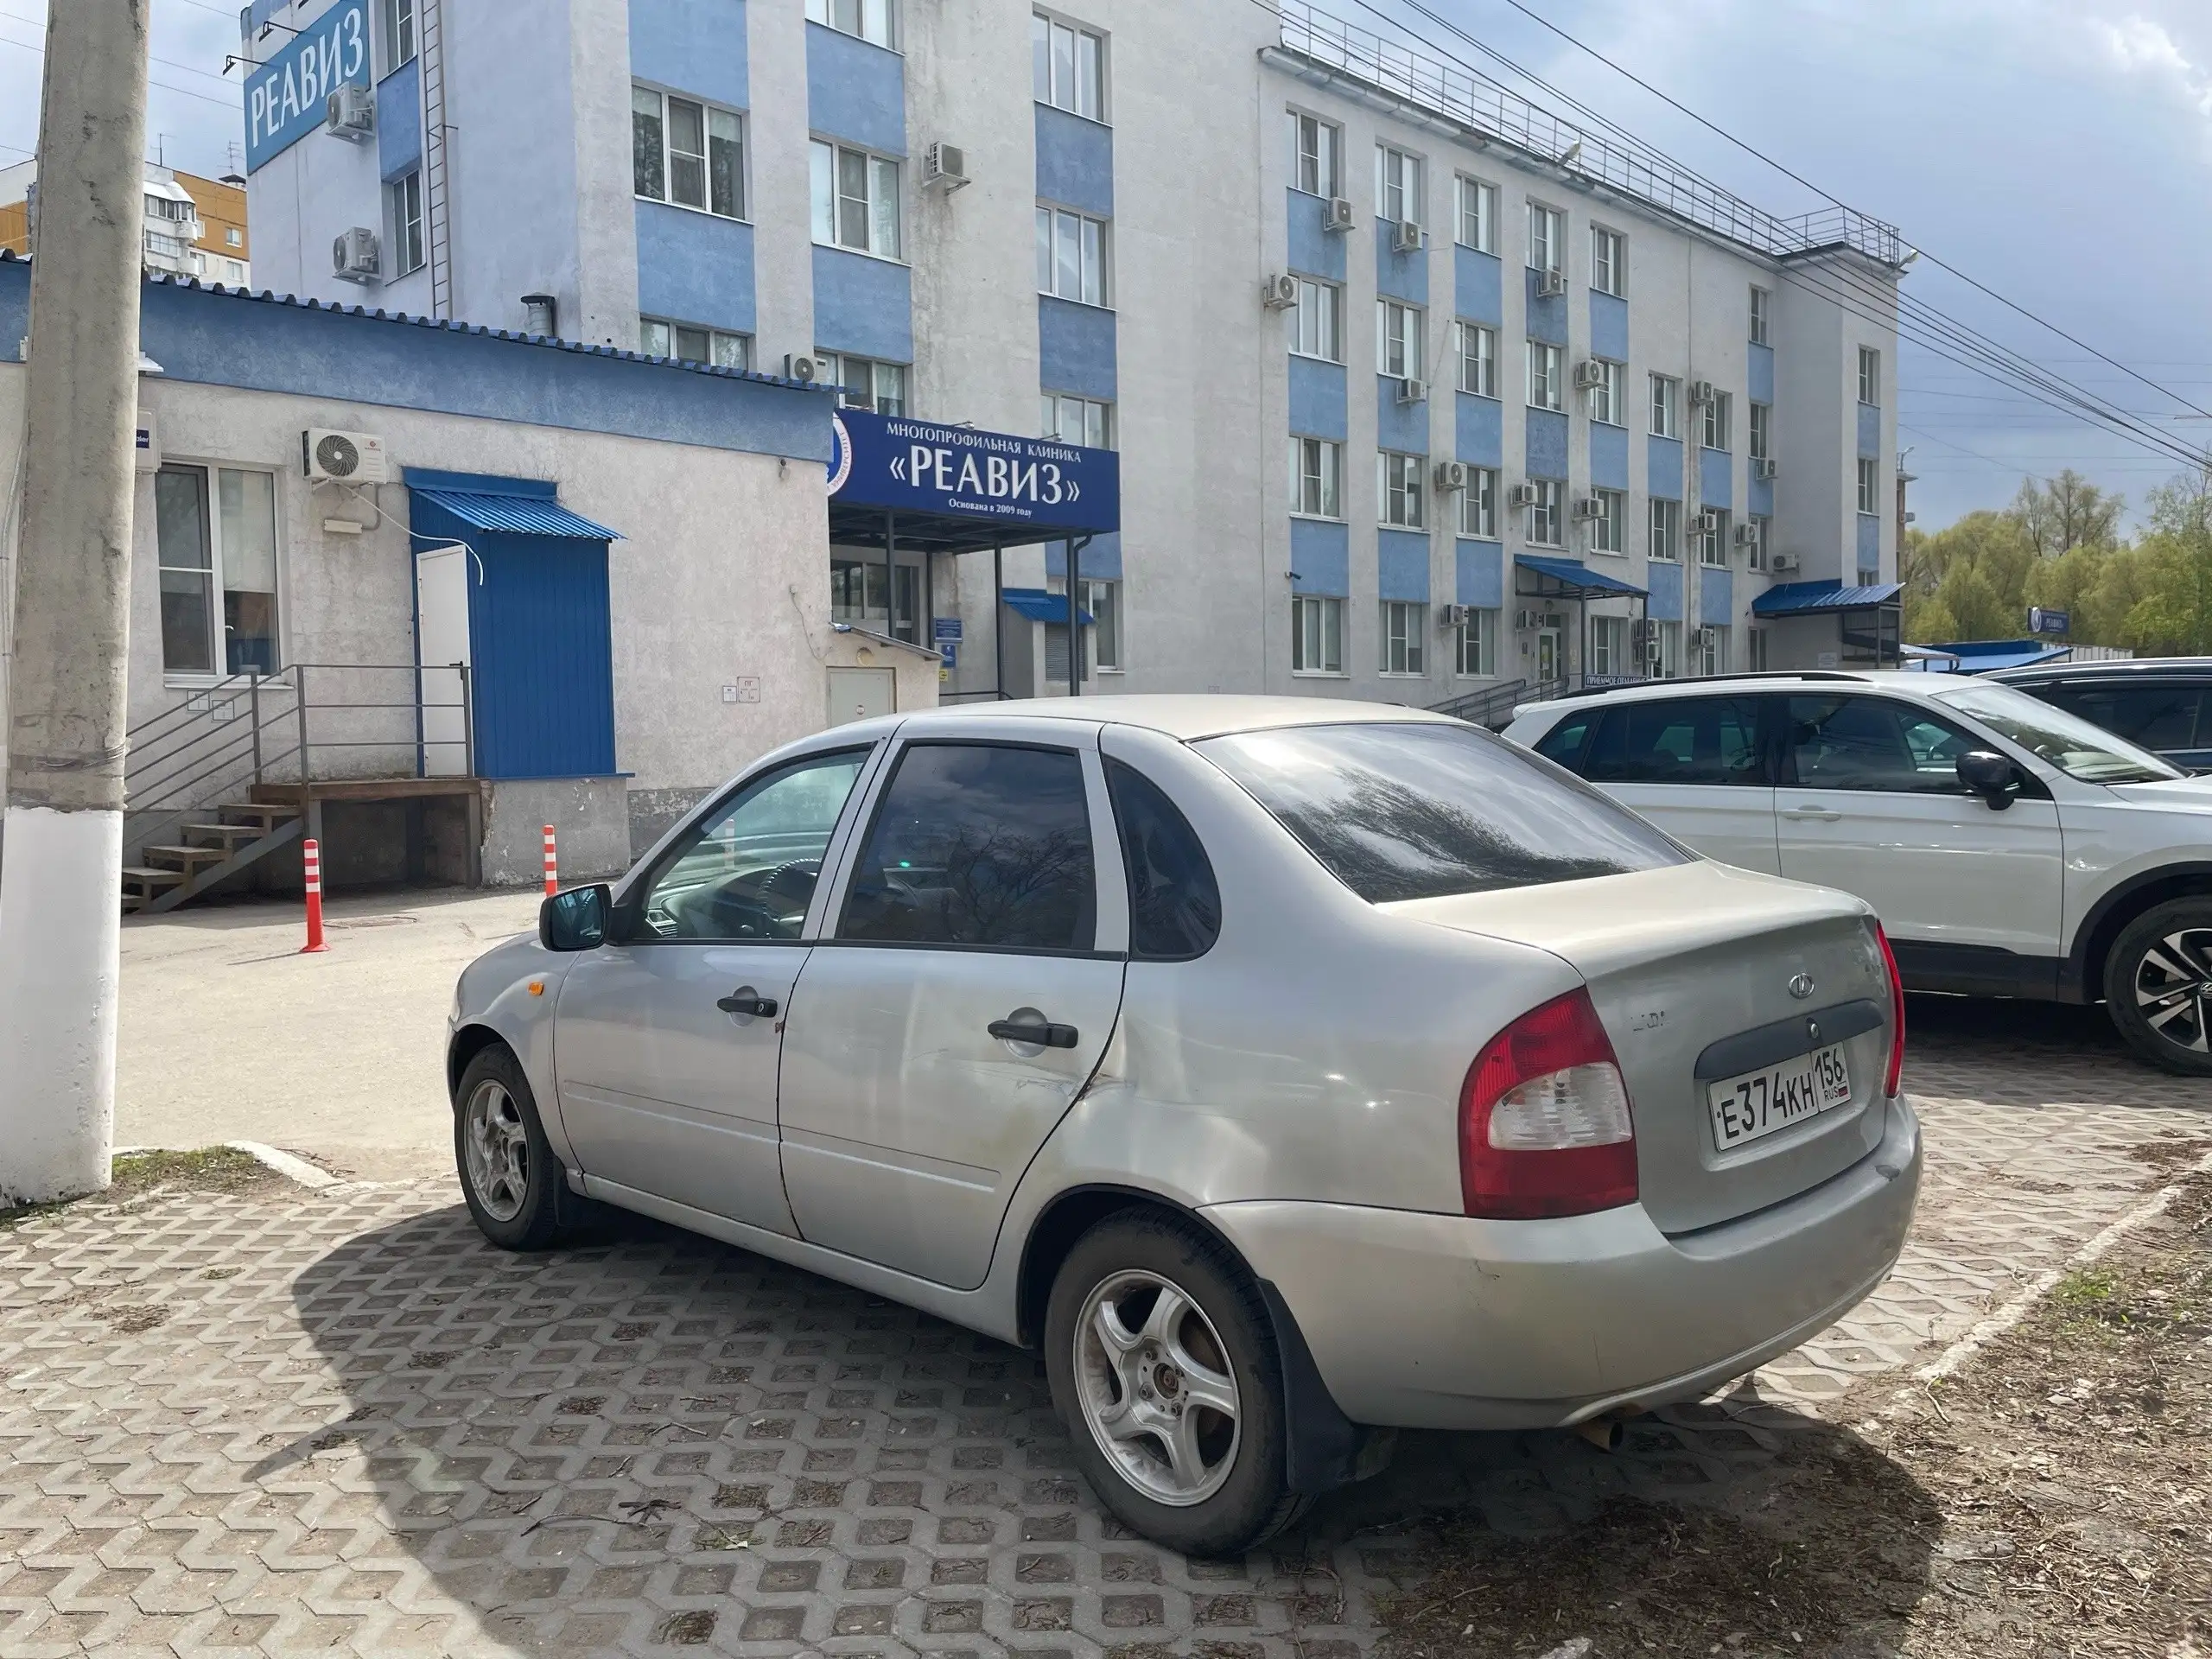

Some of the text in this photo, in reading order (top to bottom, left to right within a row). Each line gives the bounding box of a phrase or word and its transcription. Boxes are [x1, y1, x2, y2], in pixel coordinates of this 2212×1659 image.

[251, 8, 363, 148] РЕАВИЗ
[887, 422, 1082, 463] МНОГОПРОФИЛЬНАЯ КЛИНИКА
[889, 445, 1080, 505] «РЕАВИЗ»
[949, 498, 988, 512] Основана
[996, 504, 1015, 515] 2009
[1016, 508, 1033, 518] году
[1815, 1048, 1843, 1090] 156
[1824, 1086, 1839, 1102] RUS
